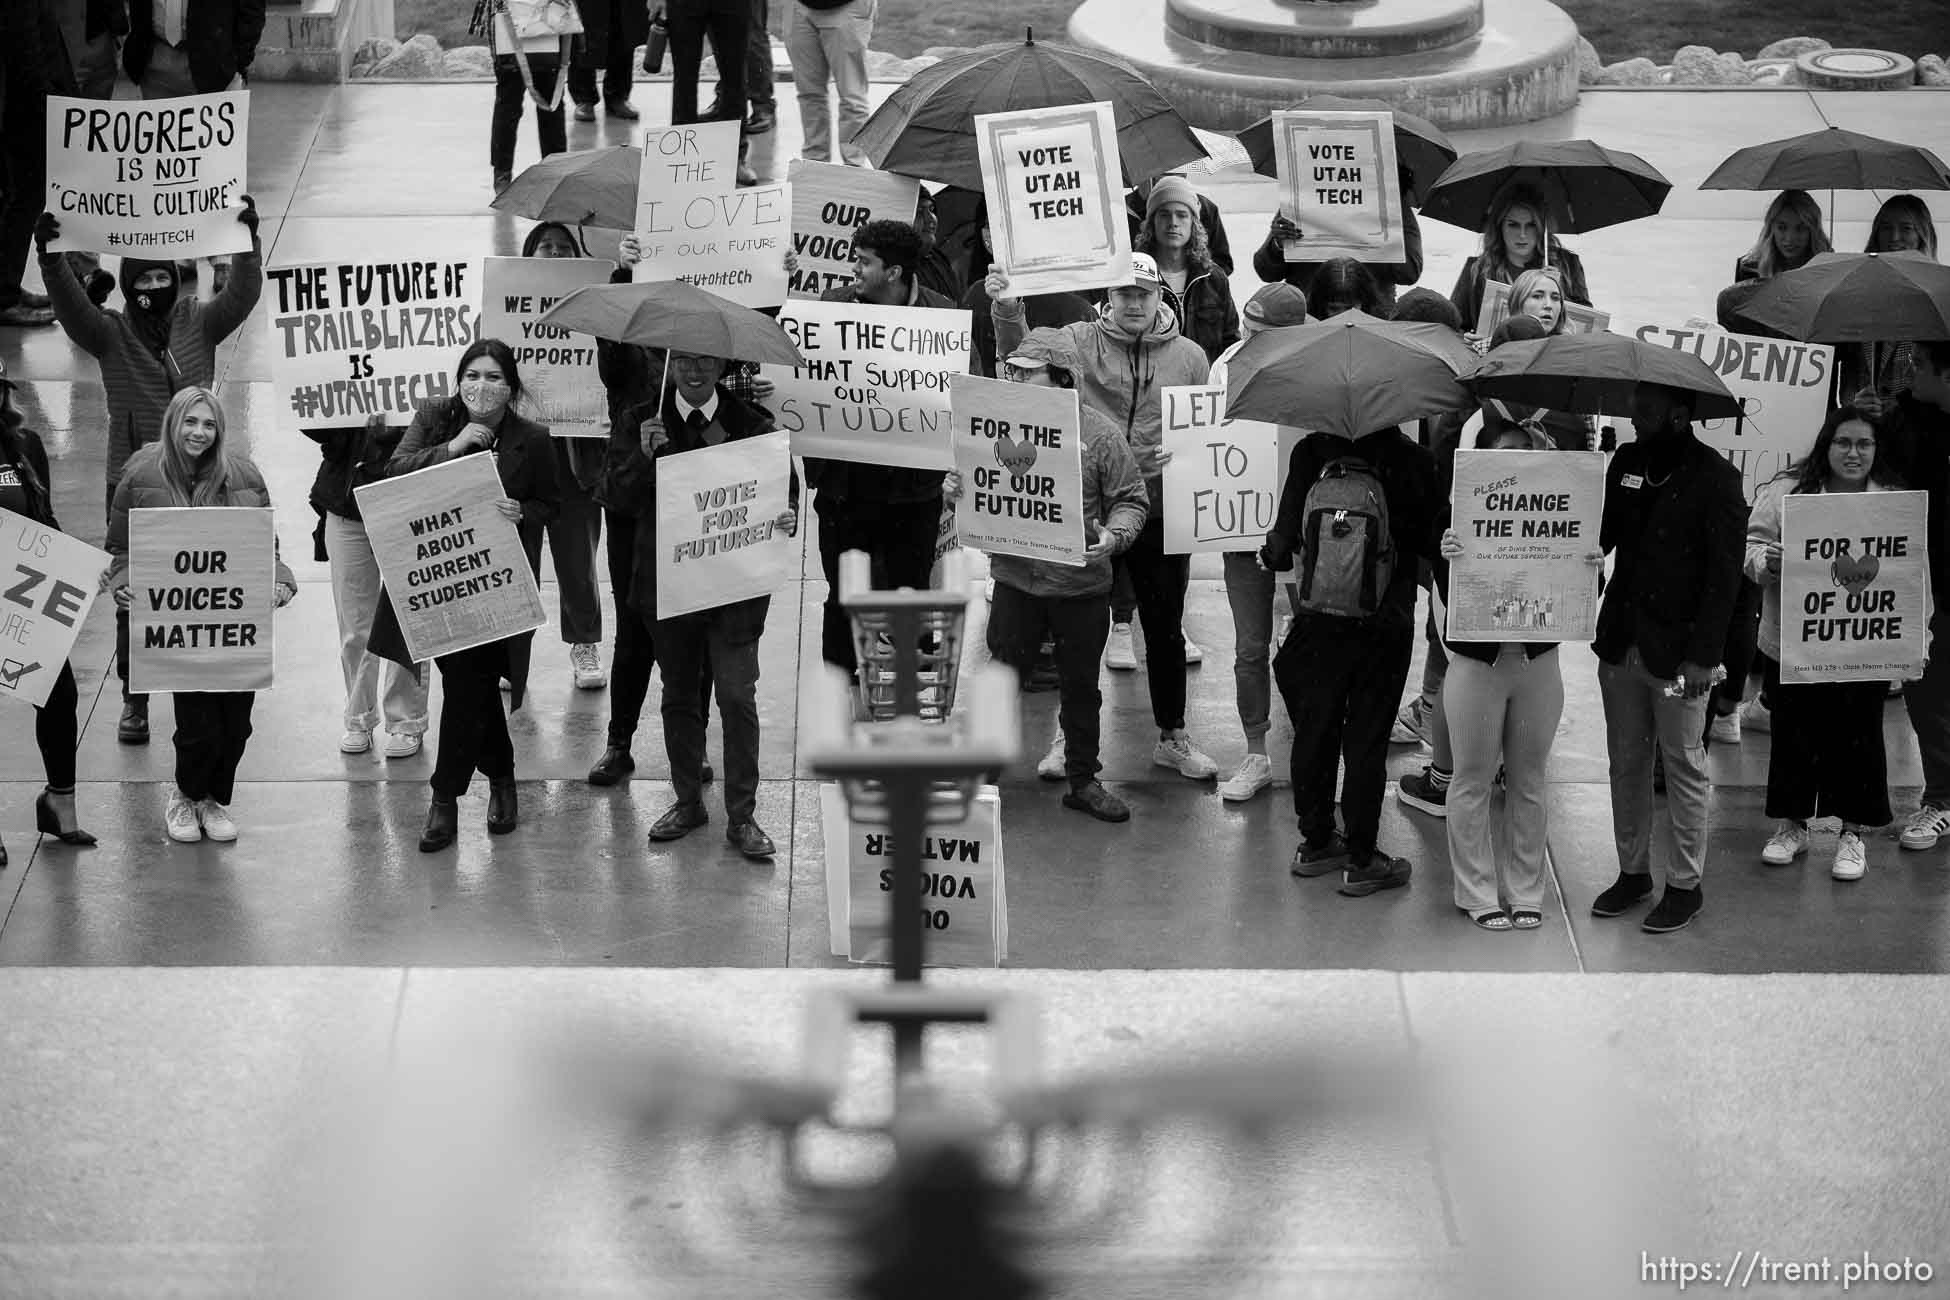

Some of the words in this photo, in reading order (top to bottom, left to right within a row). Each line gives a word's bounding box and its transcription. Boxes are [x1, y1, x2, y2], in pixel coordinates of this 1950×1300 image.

[63, 102, 235, 154] PROGRESS
[645, 129, 699, 157] FOR
[1309, 145, 1355, 160] VOTE
[1018, 145, 1072, 167] VOTE
[116, 157, 143, 182] IS
[155, 157, 200, 182] NOT
[667, 160, 716, 183] THE
[1025, 171, 1080, 193] UTAH
[1313, 167, 1361, 182] UTAH
[51, 183, 140, 218] "CANCEL
[154, 178, 238, 216] CULTURE"
[1029, 197, 1083, 220] TECH
[1316, 189, 1362, 204] TECH
[643, 188, 783, 233] LOVE
[821, 202, 871, 227] OUR
[107, 229, 195, 247] #UTAHTECH
[640, 245, 664, 259] OF
[677, 243, 719, 256] OUR
[728, 237, 776, 252] FUTURE
[267, 268, 330, 313] THE
[338, 262, 438, 307] FUTURE
[445, 263, 468, 298] OF
[504, 296, 532, 313] WE
[275, 304, 472, 358] TRAILBLAZERS
[780, 318, 820, 350] BE
[834, 321, 885, 350] THE
[891, 327, 969, 356] CHANGE
[349, 354, 374, 380] IS
[513, 347, 594, 366] UPPORT!
[866, 362, 954, 392] SUPPOR
[290, 372, 449, 419] #UTAHTECH
[834, 386, 881, 405] OUR
[971, 417, 1010, 440] FOR
[1019, 424, 1062, 449] THE
[1206, 443, 1248, 478] TO
[974, 467, 1000, 490] OF
[1010, 474, 1055, 498] OUR
[1473, 476, 1518, 496] PLEASE
[694, 480, 757, 512] VOTE
[975, 492, 1063, 523] FUTURE
[1486, 494, 1570, 511] CHANGE
[409, 507, 463, 537] WHAT
[702, 506, 748, 535] FOR
[1473, 520, 1513, 537] THE
[1521, 520, 1581, 537] NAME
[17, 527, 51, 558] US
[416, 528, 475, 560] ABOUT
[1805, 538, 1850, 560] FOR
[1861, 536, 1908, 557] THE
[174, 550, 227, 574] OUR
[407, 548, 491, 587] CURRENT
[3, 563, 87, 629] ZE
[148, 587, 245, 611] VOICES
[408, 568, 513, 612] STUDENTS?
[1804, 592, 1836, 614] OF
[1846, 590, 1896, 613] OUR
[144, 624, 257, 648] MATTER
[1802, 617, 1902, 642] FUTURE
